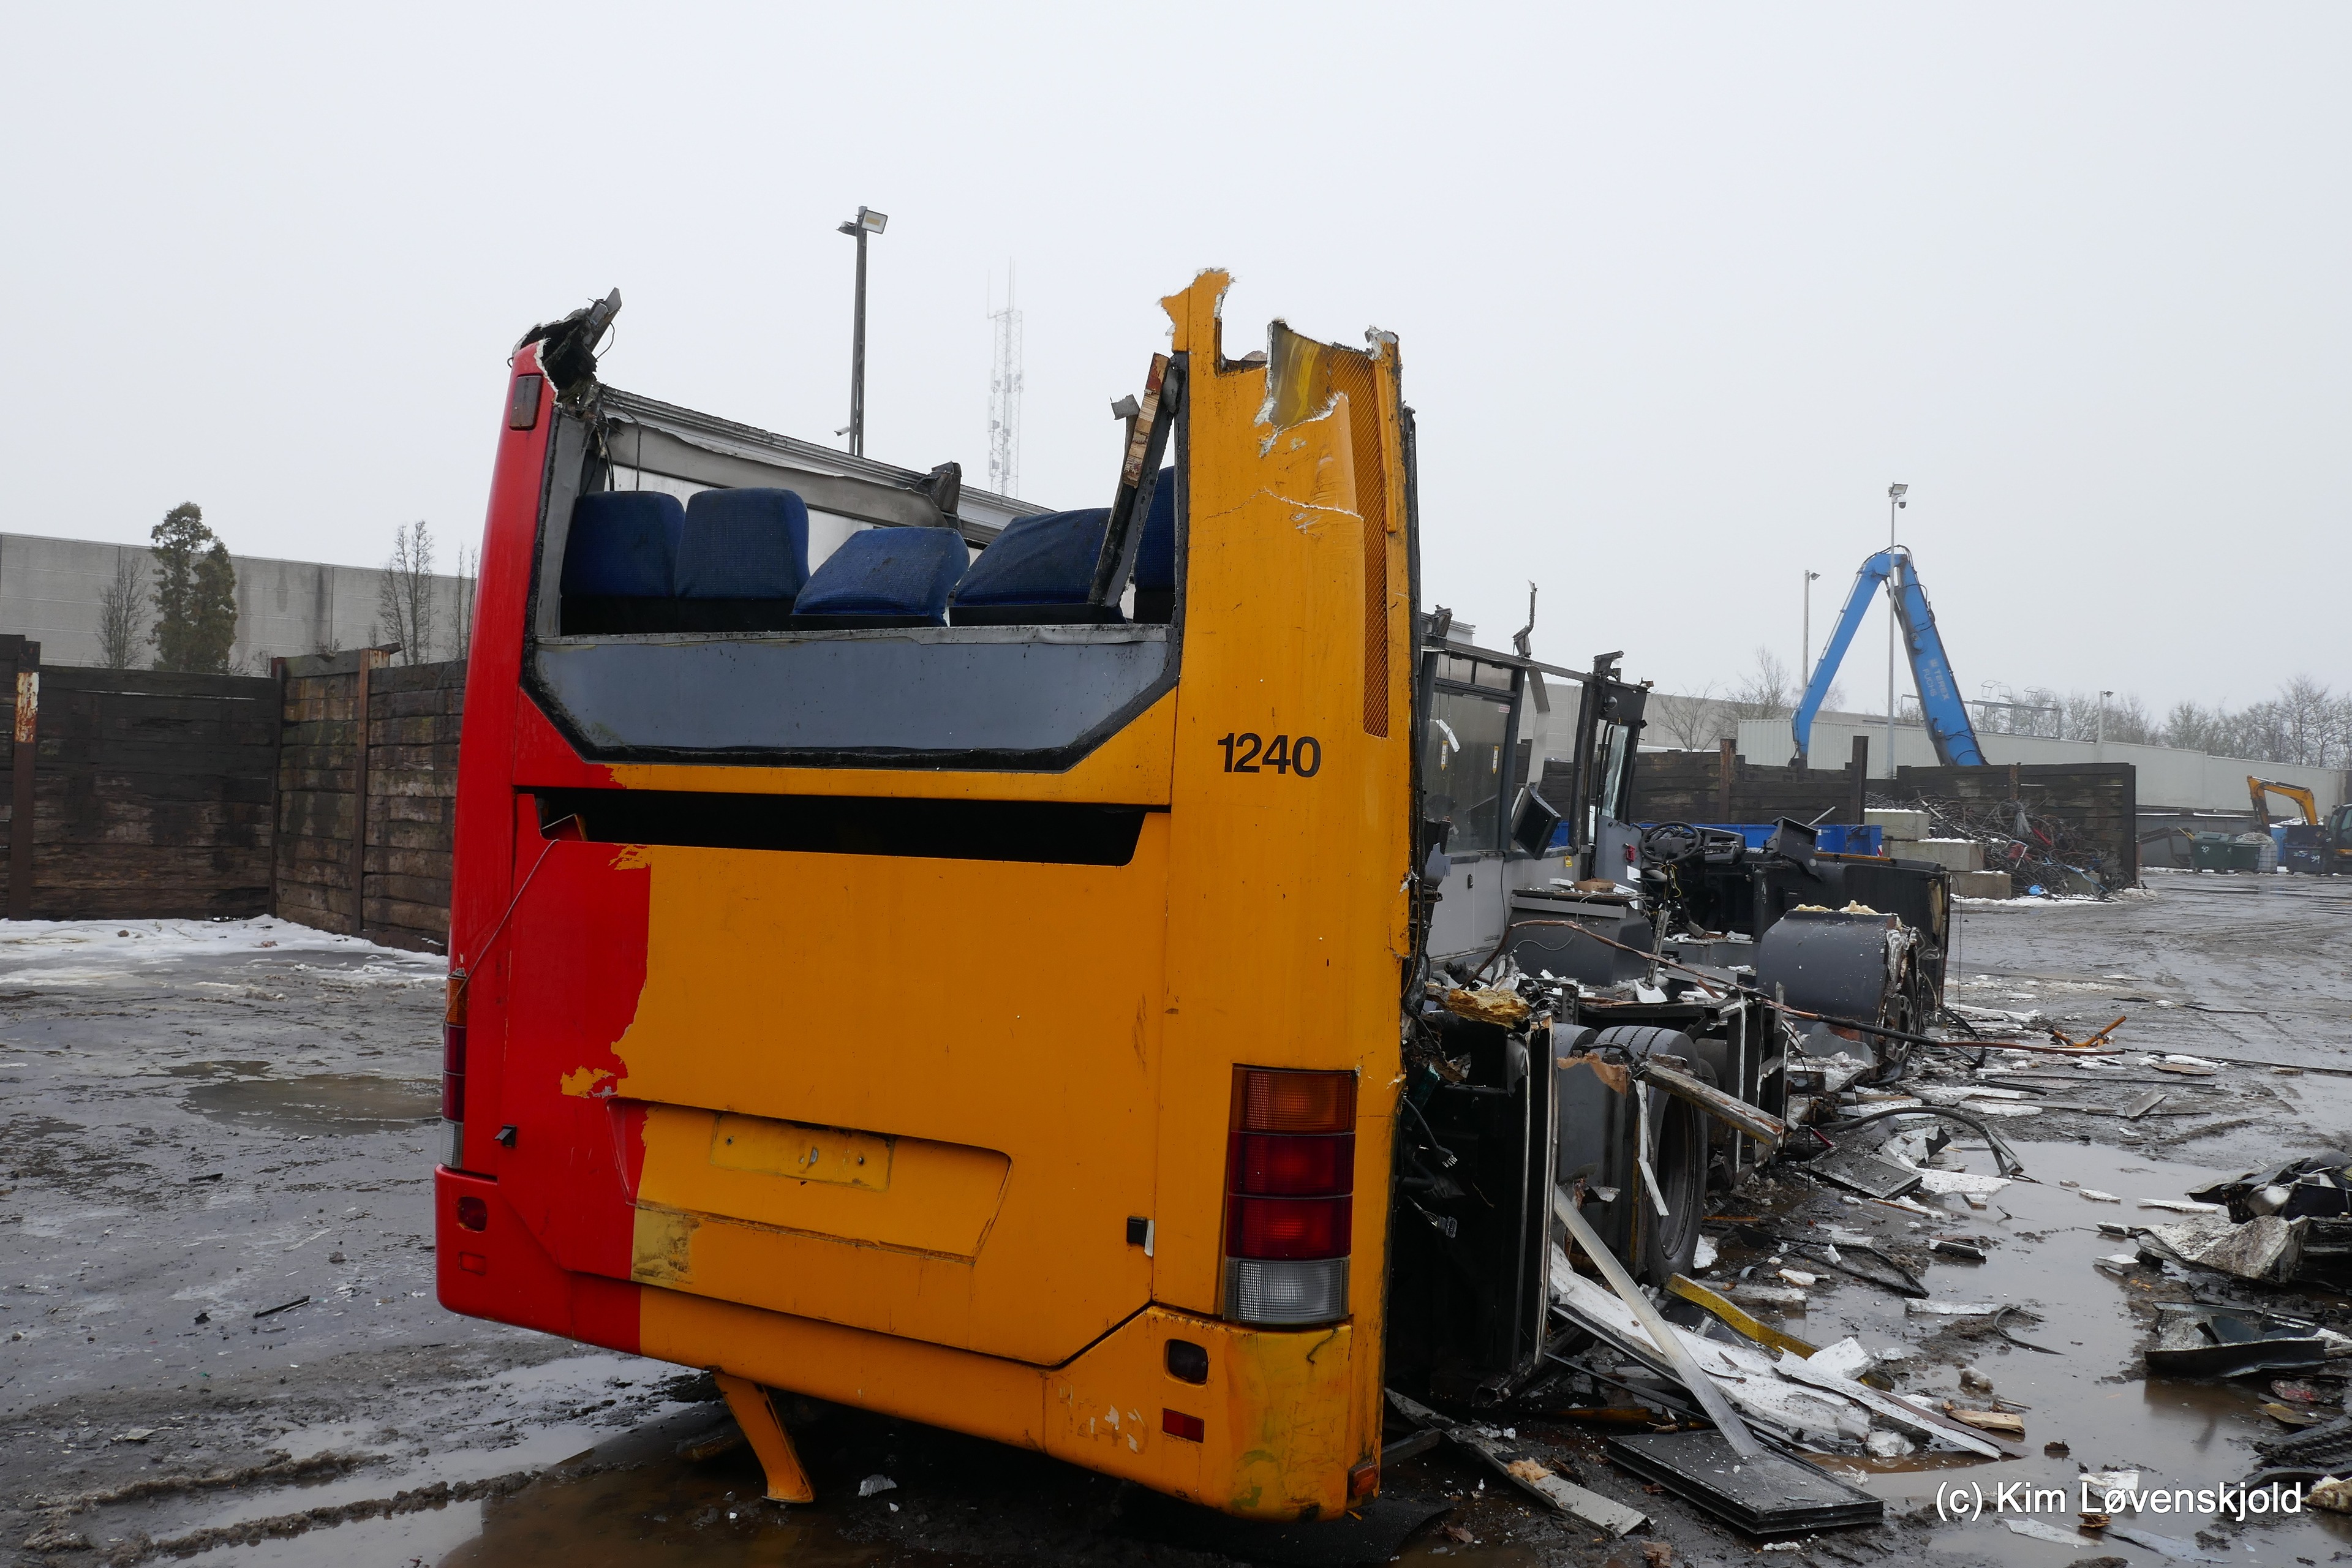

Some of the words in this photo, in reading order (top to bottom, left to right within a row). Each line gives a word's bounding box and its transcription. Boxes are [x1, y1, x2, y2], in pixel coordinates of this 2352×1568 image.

[1922, 668, 1937, 696] FUCHS
[1934, 668, 1950, 701] TEREX
[1217, 733, 1321, 778] 1240
